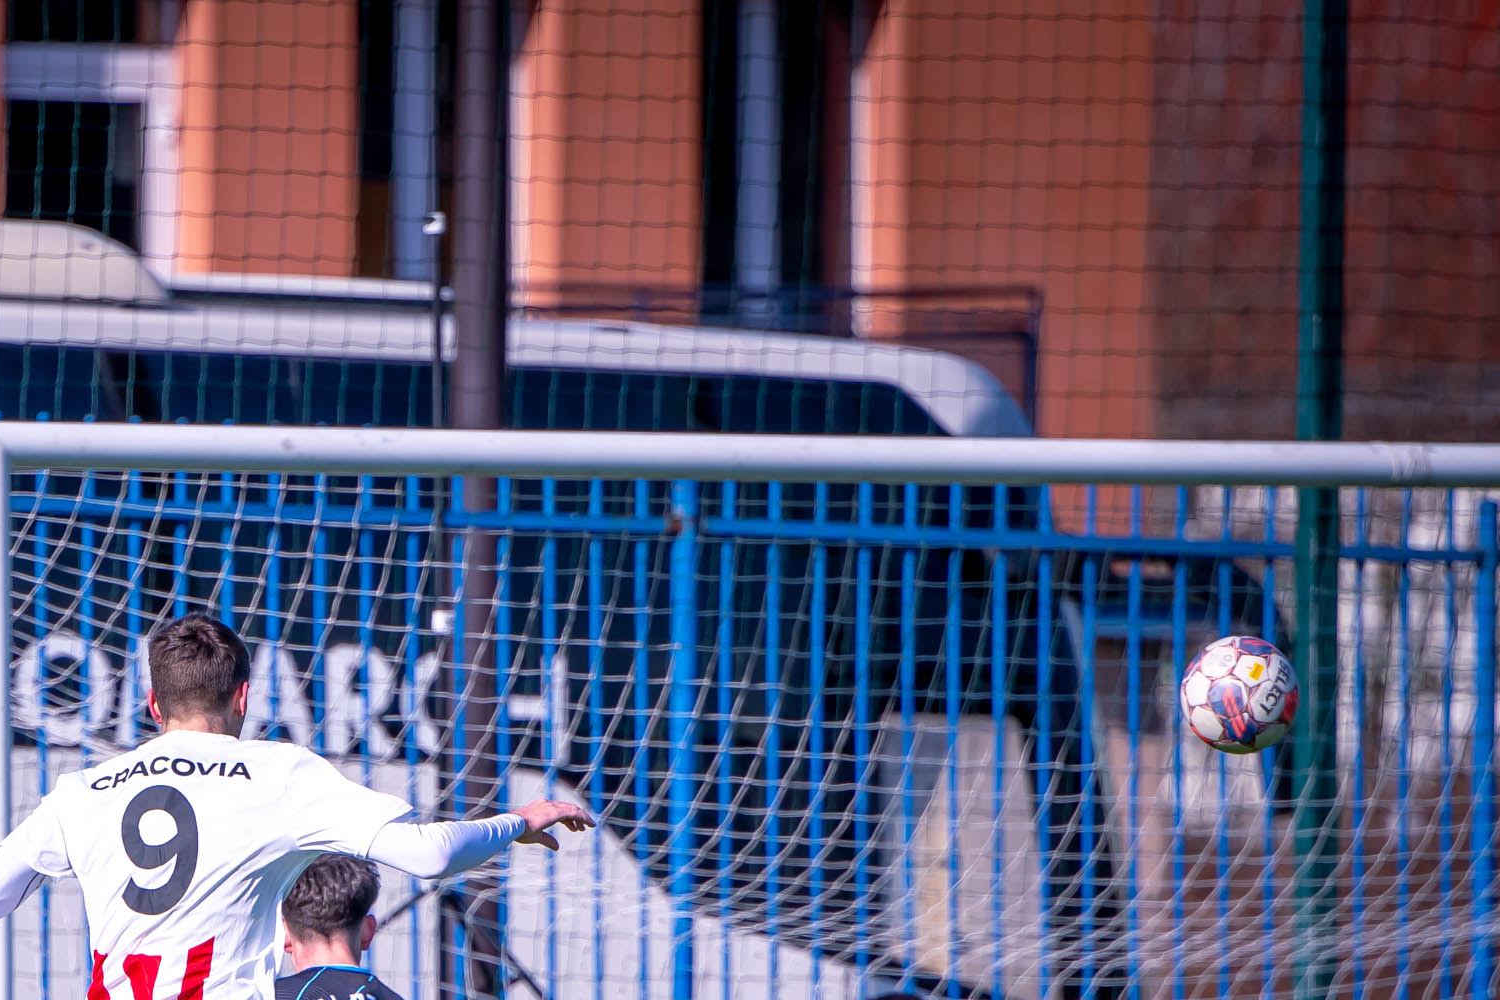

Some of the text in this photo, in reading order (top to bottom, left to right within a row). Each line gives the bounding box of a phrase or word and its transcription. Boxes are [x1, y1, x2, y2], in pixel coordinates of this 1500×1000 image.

[1260, 659, 1290, 715] SELECT
[91, 756, 252, 791] CRACOVIA
[121, 785, 198, 916] 9
